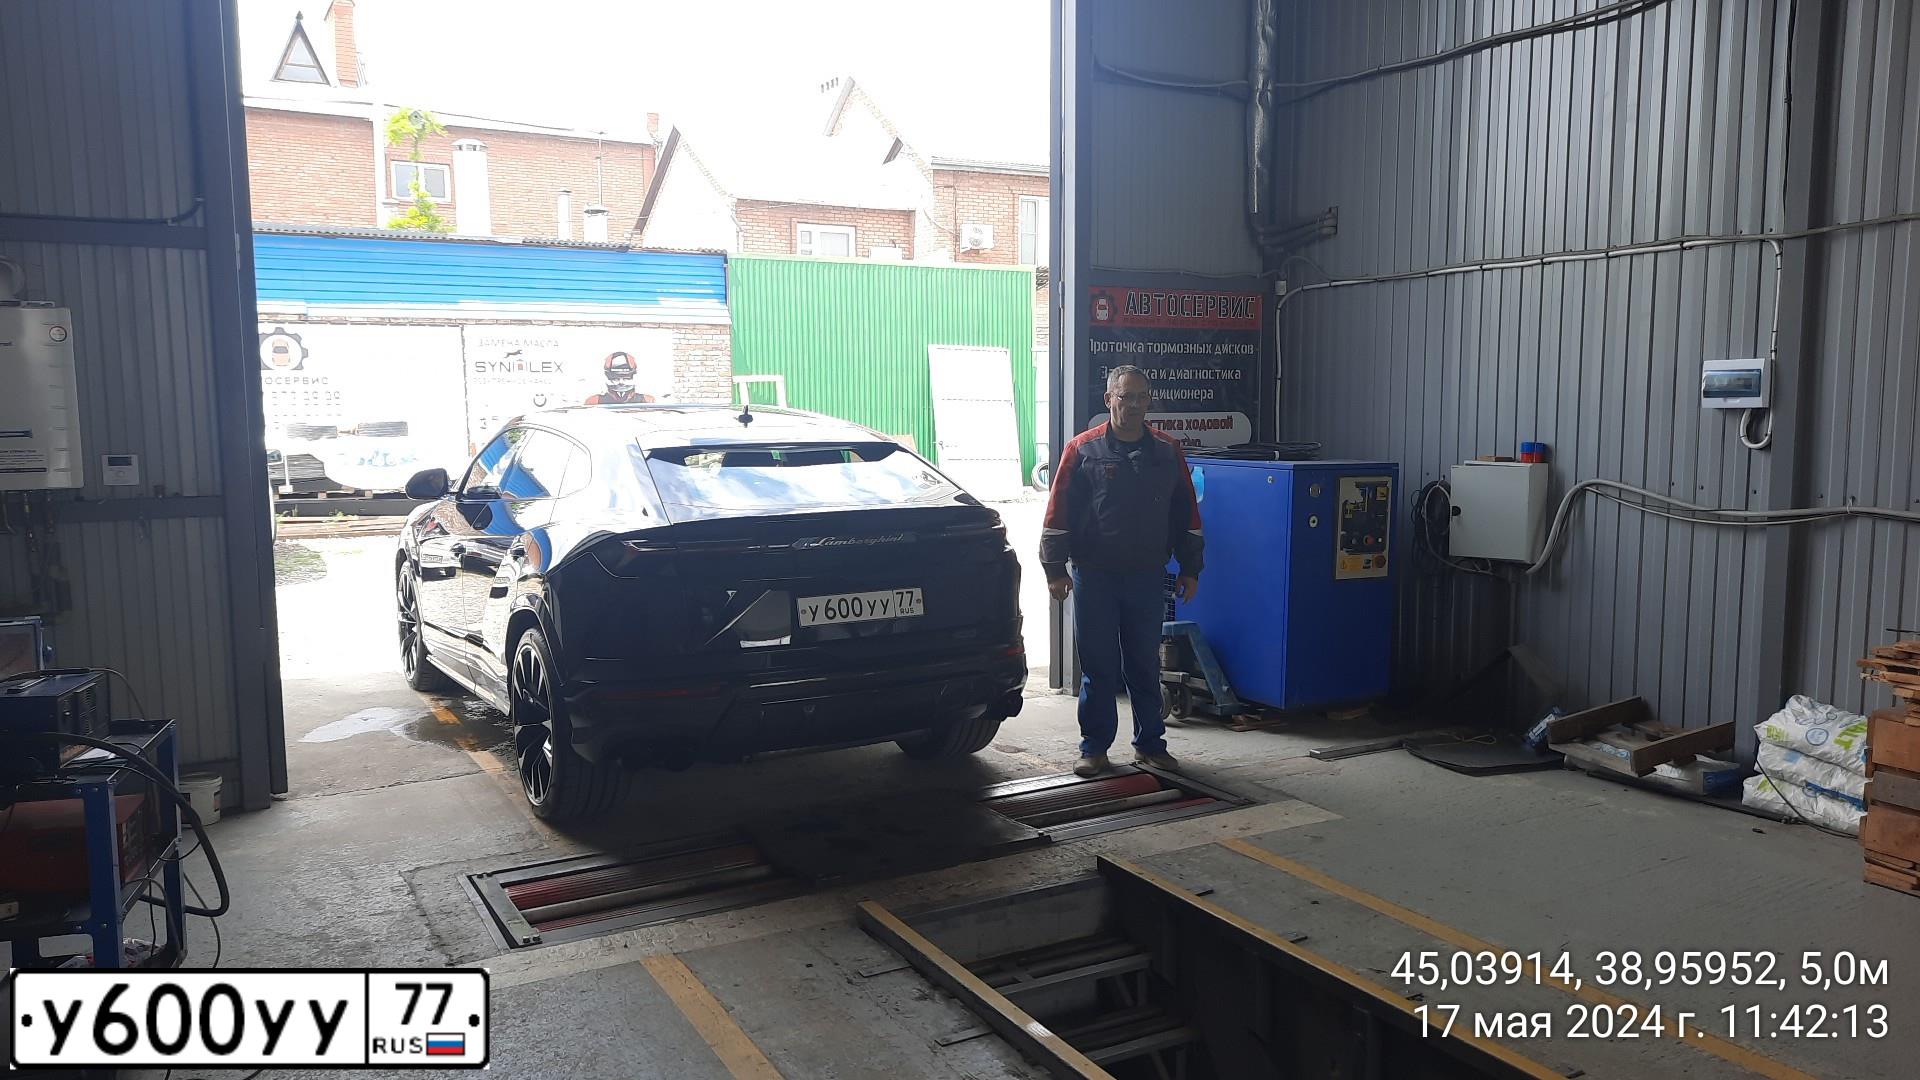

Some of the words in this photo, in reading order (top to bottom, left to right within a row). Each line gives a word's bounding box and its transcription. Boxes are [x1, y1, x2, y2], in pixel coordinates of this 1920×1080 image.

[1124, 290, 1255, 319] АВТОСЕРВИС
[1147, 341, 1212, 356] тормозных
[1215, 341, 1254, 355] дисков
[264, 376, 329, 385] ОСЕРВИС
[1159, 369, 1167, 380] и
[1169, 368, 1241, 381] диагностика
[1149, 388, 1214, 403] диционера
[895, 591, 915, 608] 77
[899, 607, 915, 615] RUS
